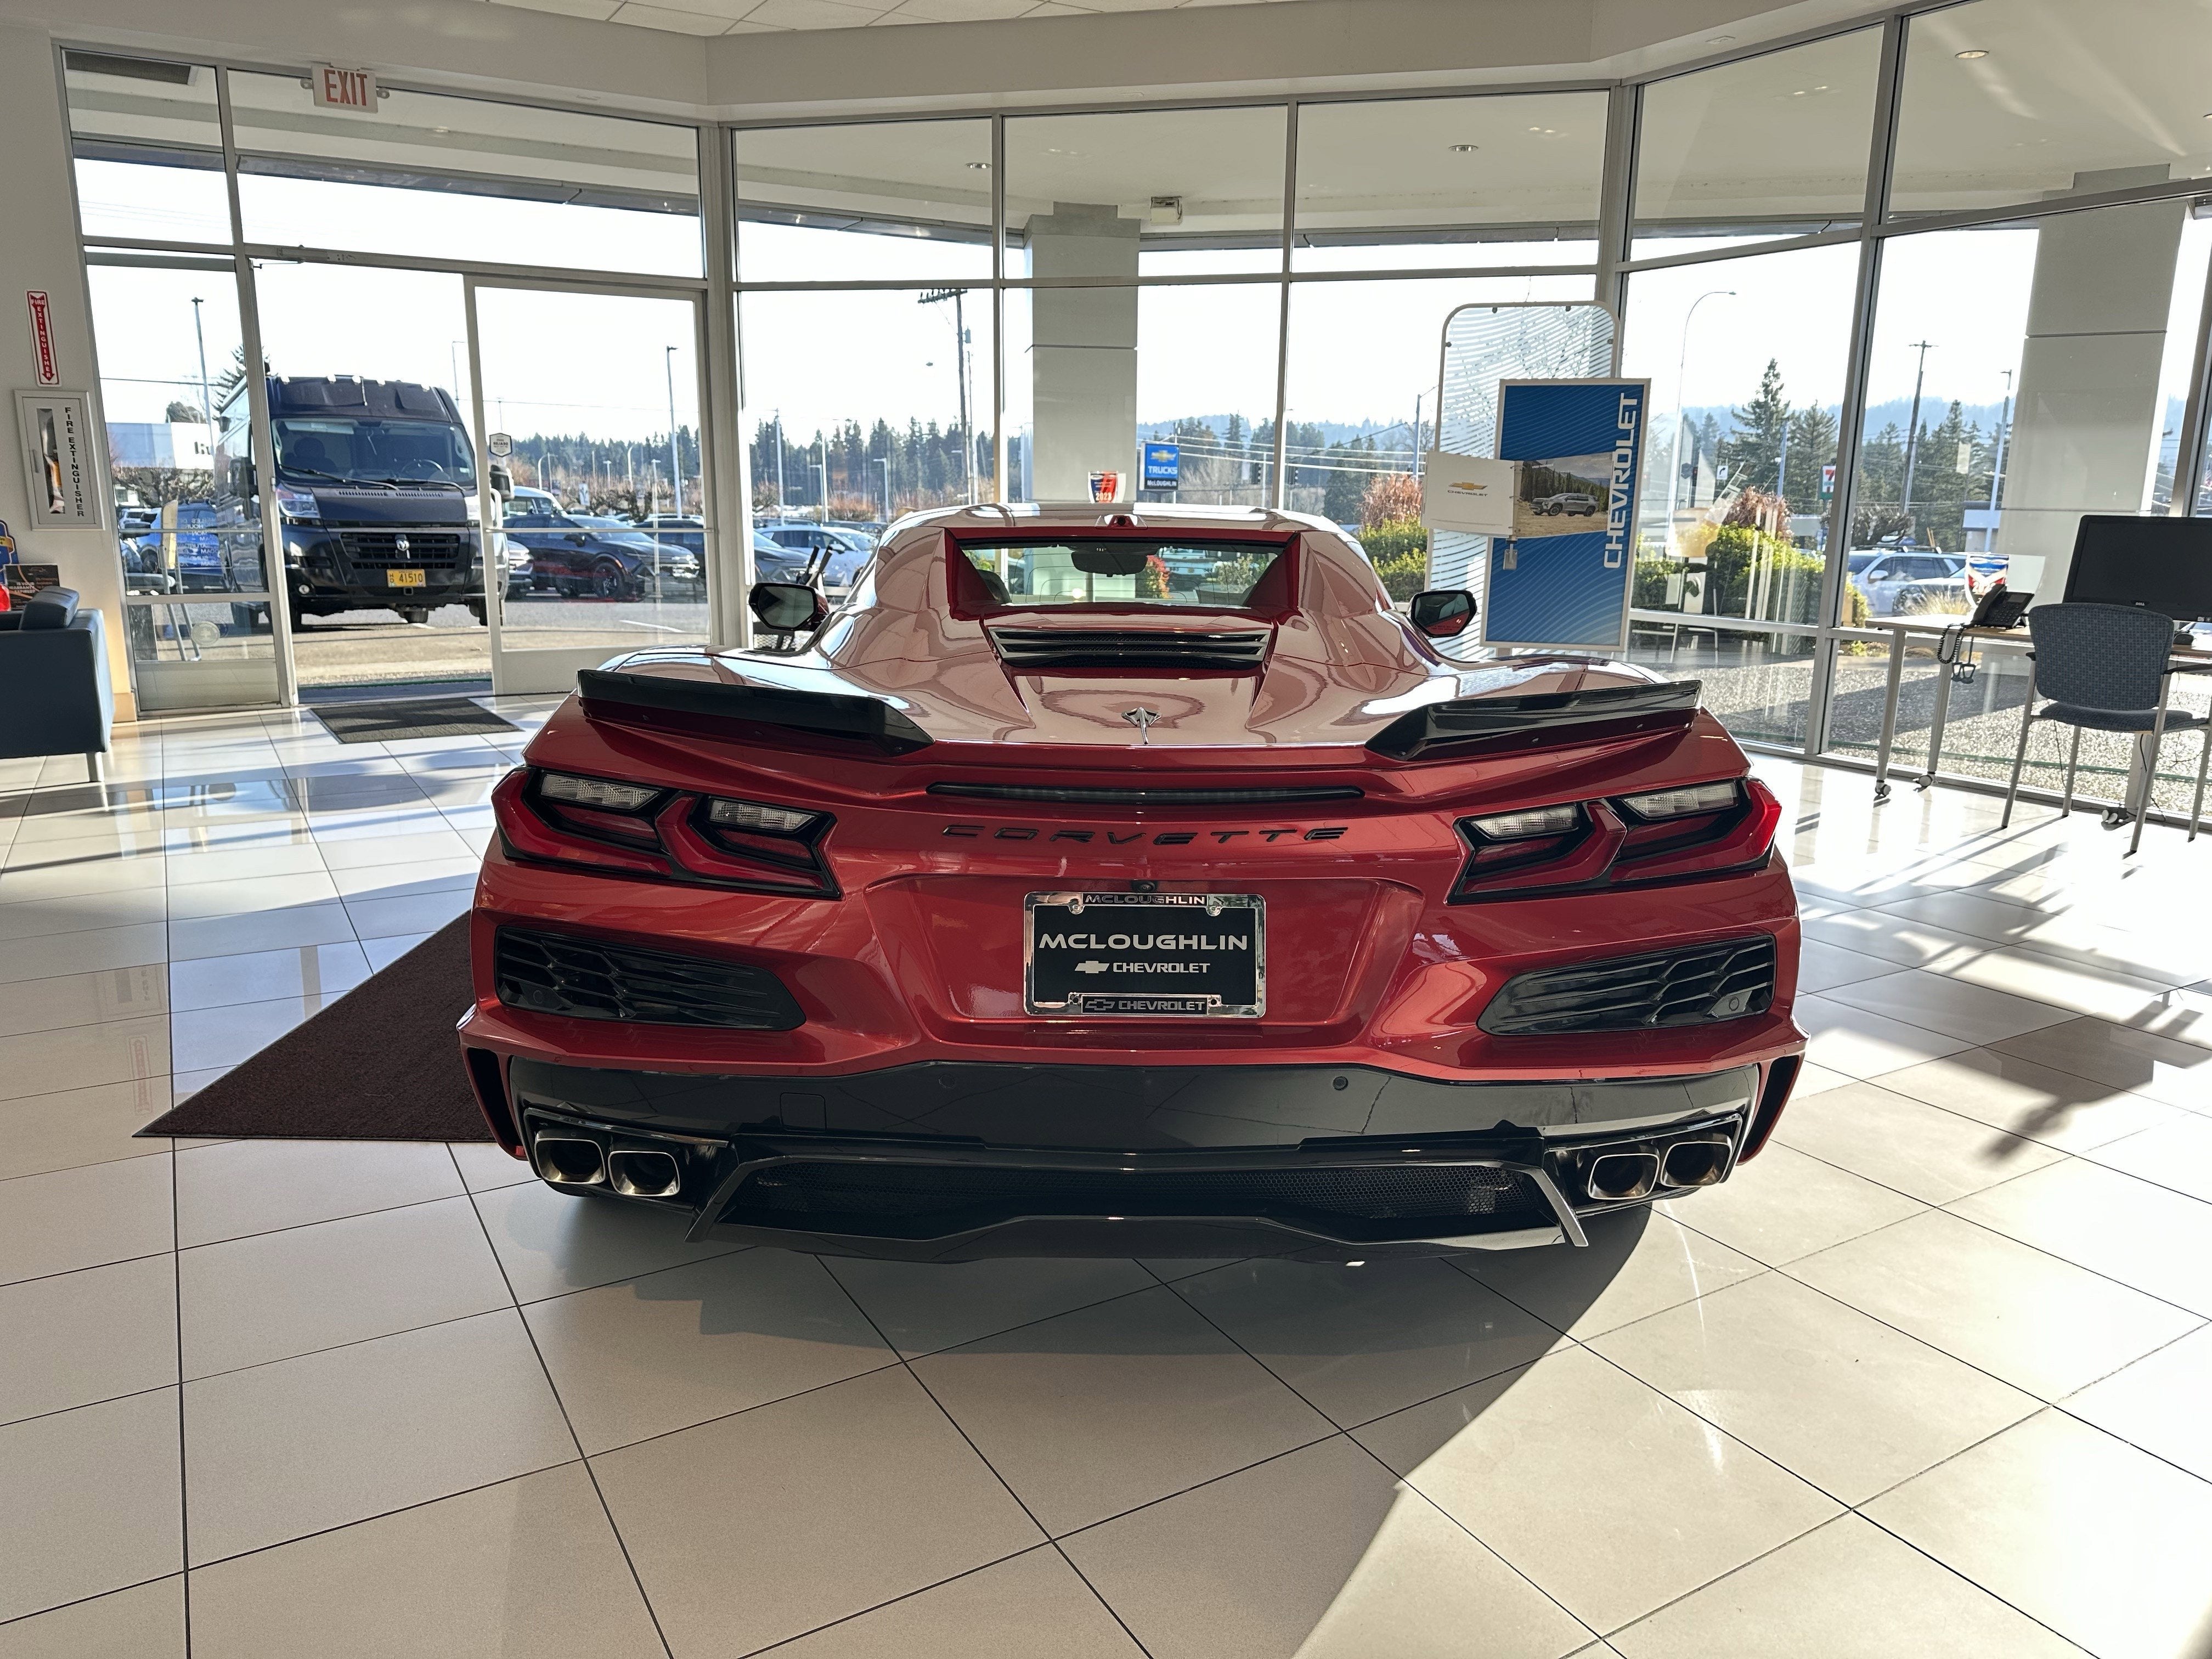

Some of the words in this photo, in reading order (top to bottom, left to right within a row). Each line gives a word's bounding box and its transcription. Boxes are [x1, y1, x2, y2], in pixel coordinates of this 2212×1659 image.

[324, 69, 368, 106] EXIT
[37, 306, 51, 377] EXTINGUISHER
[65, 407, 74, 433] FIRE
[68, 437, 84, 517] EXTINGUISHER
[1148, 466, 1178, 475] TRUCKS
[1603, 392, 1638, 569] CHEVROLET
[399, 573, 423, 583] 41510
[941, 823, 1350, 846] CORVETTE
[1085, 894, 1206, 905] MCLOUGHLIN
[1039, 934, 1248, 951] MCLOUGHLIN
[1113, 962, 1211, 974] CHEVROLET
[1118, 1000, 1205, 1012] CHEVROLET
